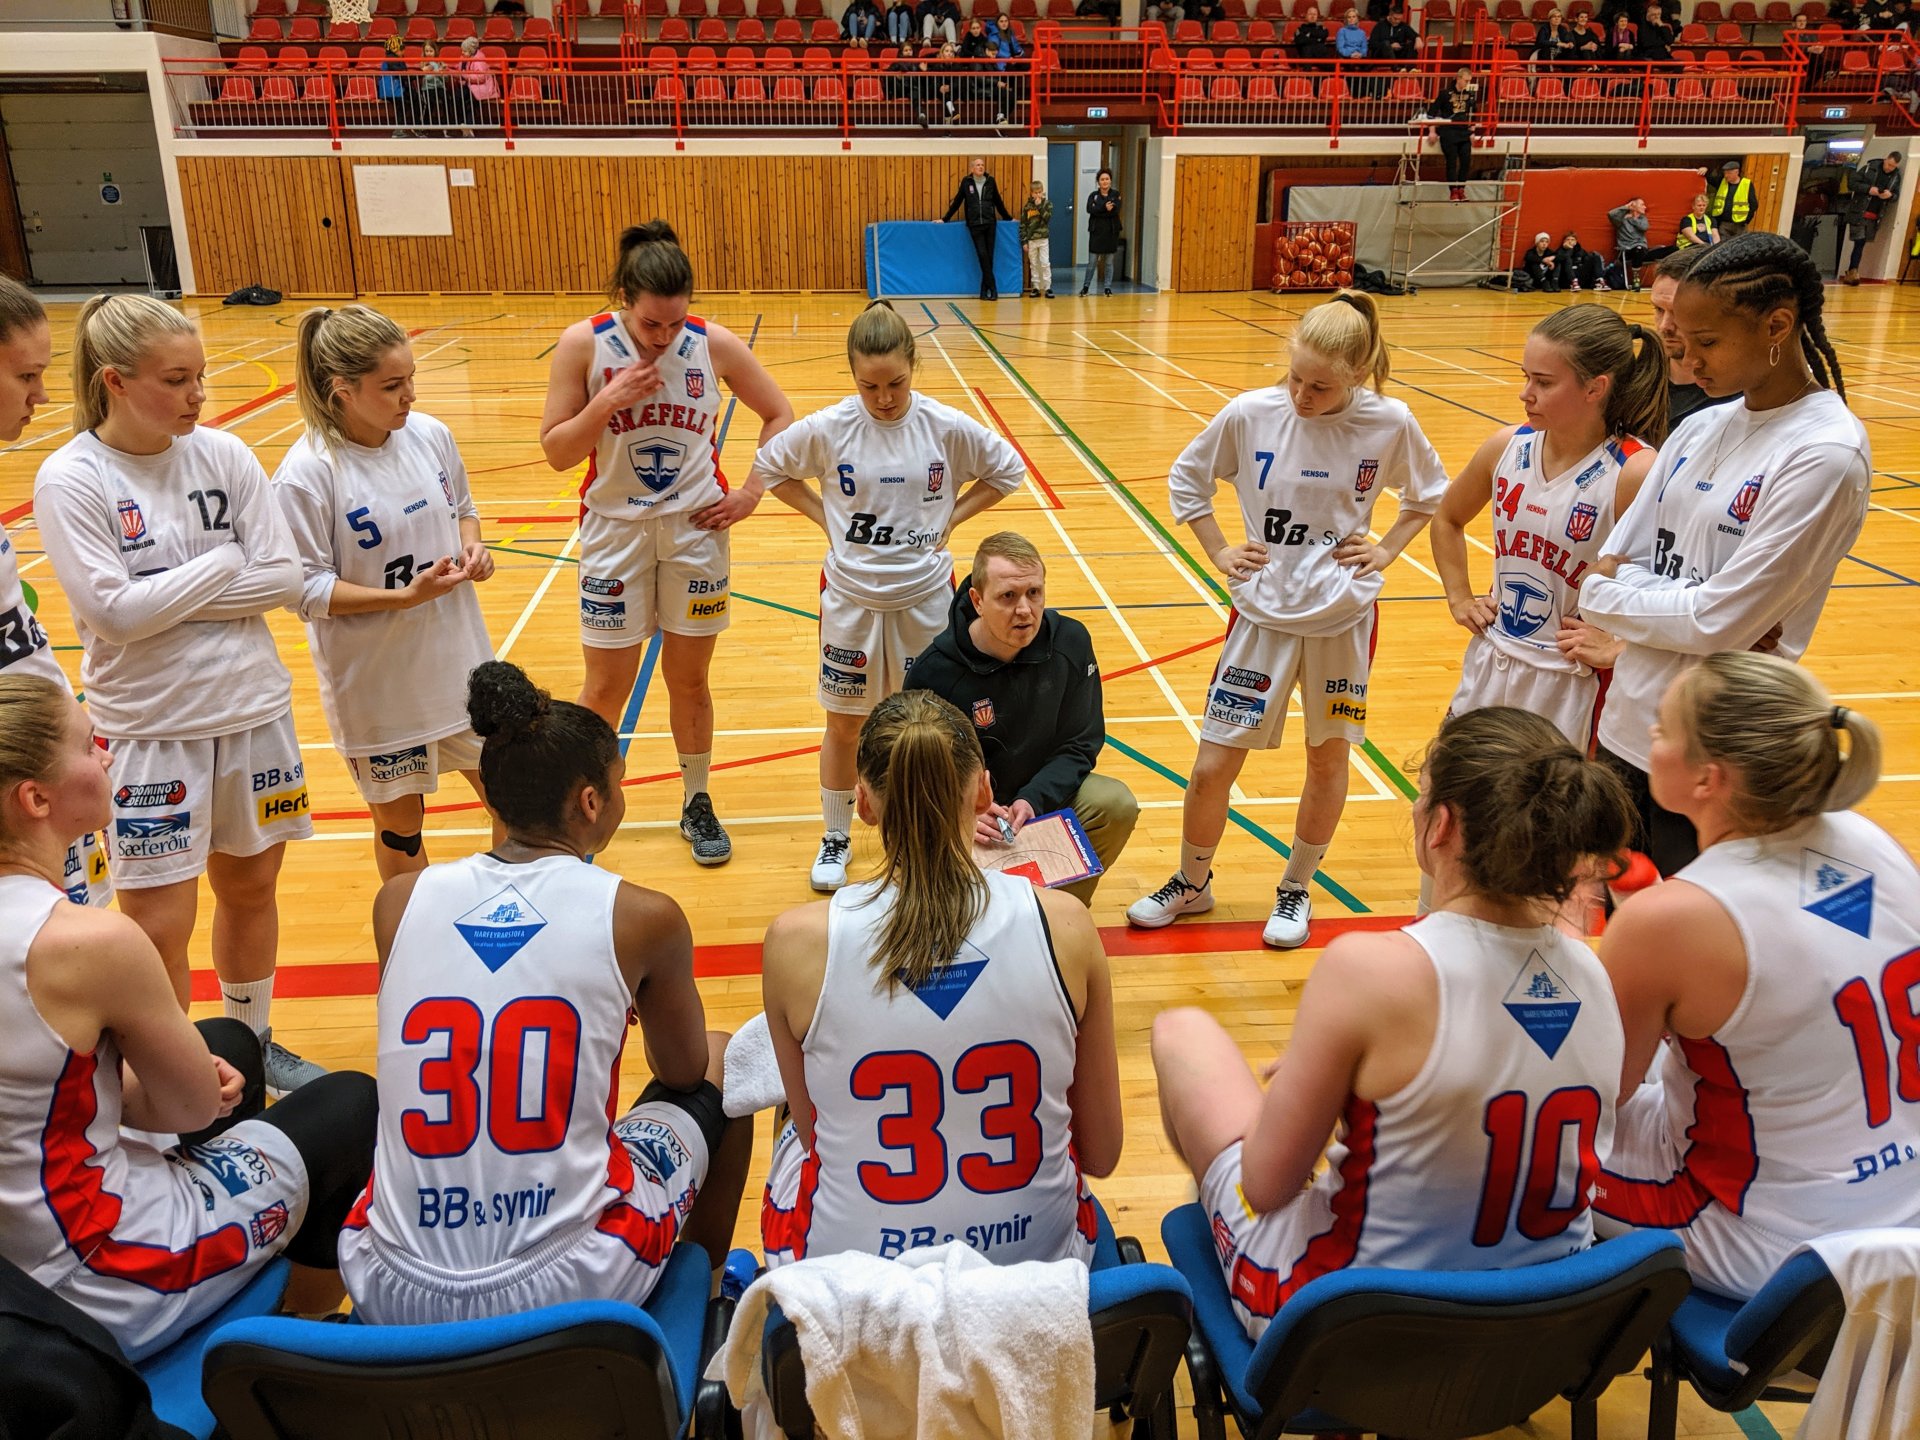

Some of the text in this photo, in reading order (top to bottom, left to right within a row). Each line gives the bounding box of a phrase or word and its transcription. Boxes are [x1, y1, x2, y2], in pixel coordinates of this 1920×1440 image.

[837, 464, 856, 497] 6
[1255, 451, 1275, 490] 7
[1301, 469, 1329, 478] HENSON
[187, 488, 231, 532] 12
[403, 499, 428, 516] HENSON
[1495, 477, 1526, 522] 24
[1526, 503, 1548, 516] HENSON
[346, 506, 383, 550] 5
[907, 528, 940, 549] Synir
[1308, 538, 1315, 546] &
[1495, 529, 1589, 590] NÆFELL
[688, 580, 709, 594] BB
[710, 583, 716, 592] &
[692, 600, 727, 616] Hertz
[829, 647, 862, 660] DOMINO'S
[1225, 675, 1257, 688] DEILDIN
[1229, 667, 1265, 683] DOMINO'S
[1325, 678, 1348, 694] BB
[1208, 703, 1263, 728] Sæferðir
[1331, 702, 1367, 721] Hertz
[252, 768, 281, 792] BB
[284, 771, 294, 783] &
[370, 757, 429, 780] Sæferðir
[128, 793, 168, 806] DEILDIN
[131, 782, 180, 797] DOMINO'S
[118, 834, 192, 857] Sæferðir
[401, 995, 582, 1160] 30
[849, 1039, 1044, 1205] 33
[1471, 1085, 1602, 1248] 10
[418, 1182, 556, 1230] BB & synir
[965, 1213, 1032, 1251] synir
